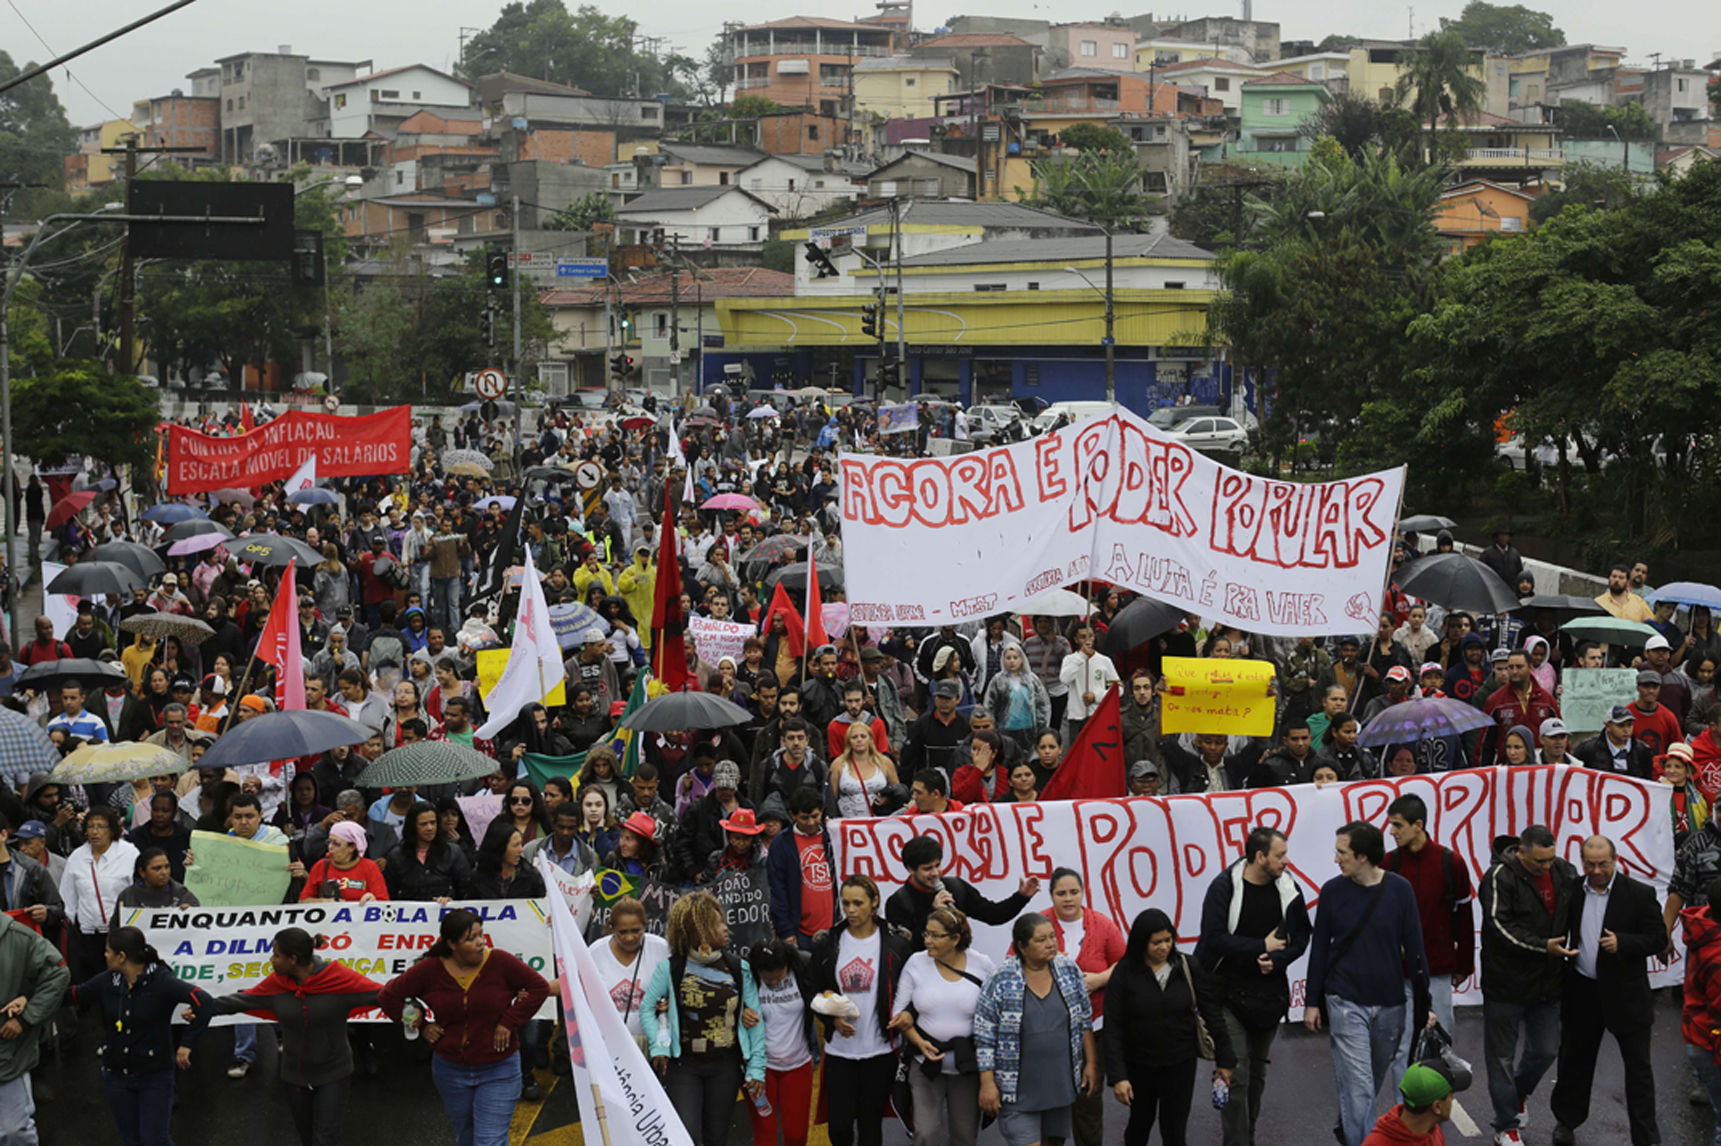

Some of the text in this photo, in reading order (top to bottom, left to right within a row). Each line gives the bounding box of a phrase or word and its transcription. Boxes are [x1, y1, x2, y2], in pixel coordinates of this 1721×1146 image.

[179, 458, 240, 481] ESCALA
[322, 441, 398, 465] SALÁRIOS
[840, 414, 1386, 569] AGORA É PODER POPULAR
[1135, 552, 1194, 600] LUTA
[717, 889, 763, 905] ANDIDO
[150, 908, 326, 930] ENQUANTO
[331, 907, 352, 923] A
[173, 940, 194, 956] A
[205, 938, 275, 956] DILM
